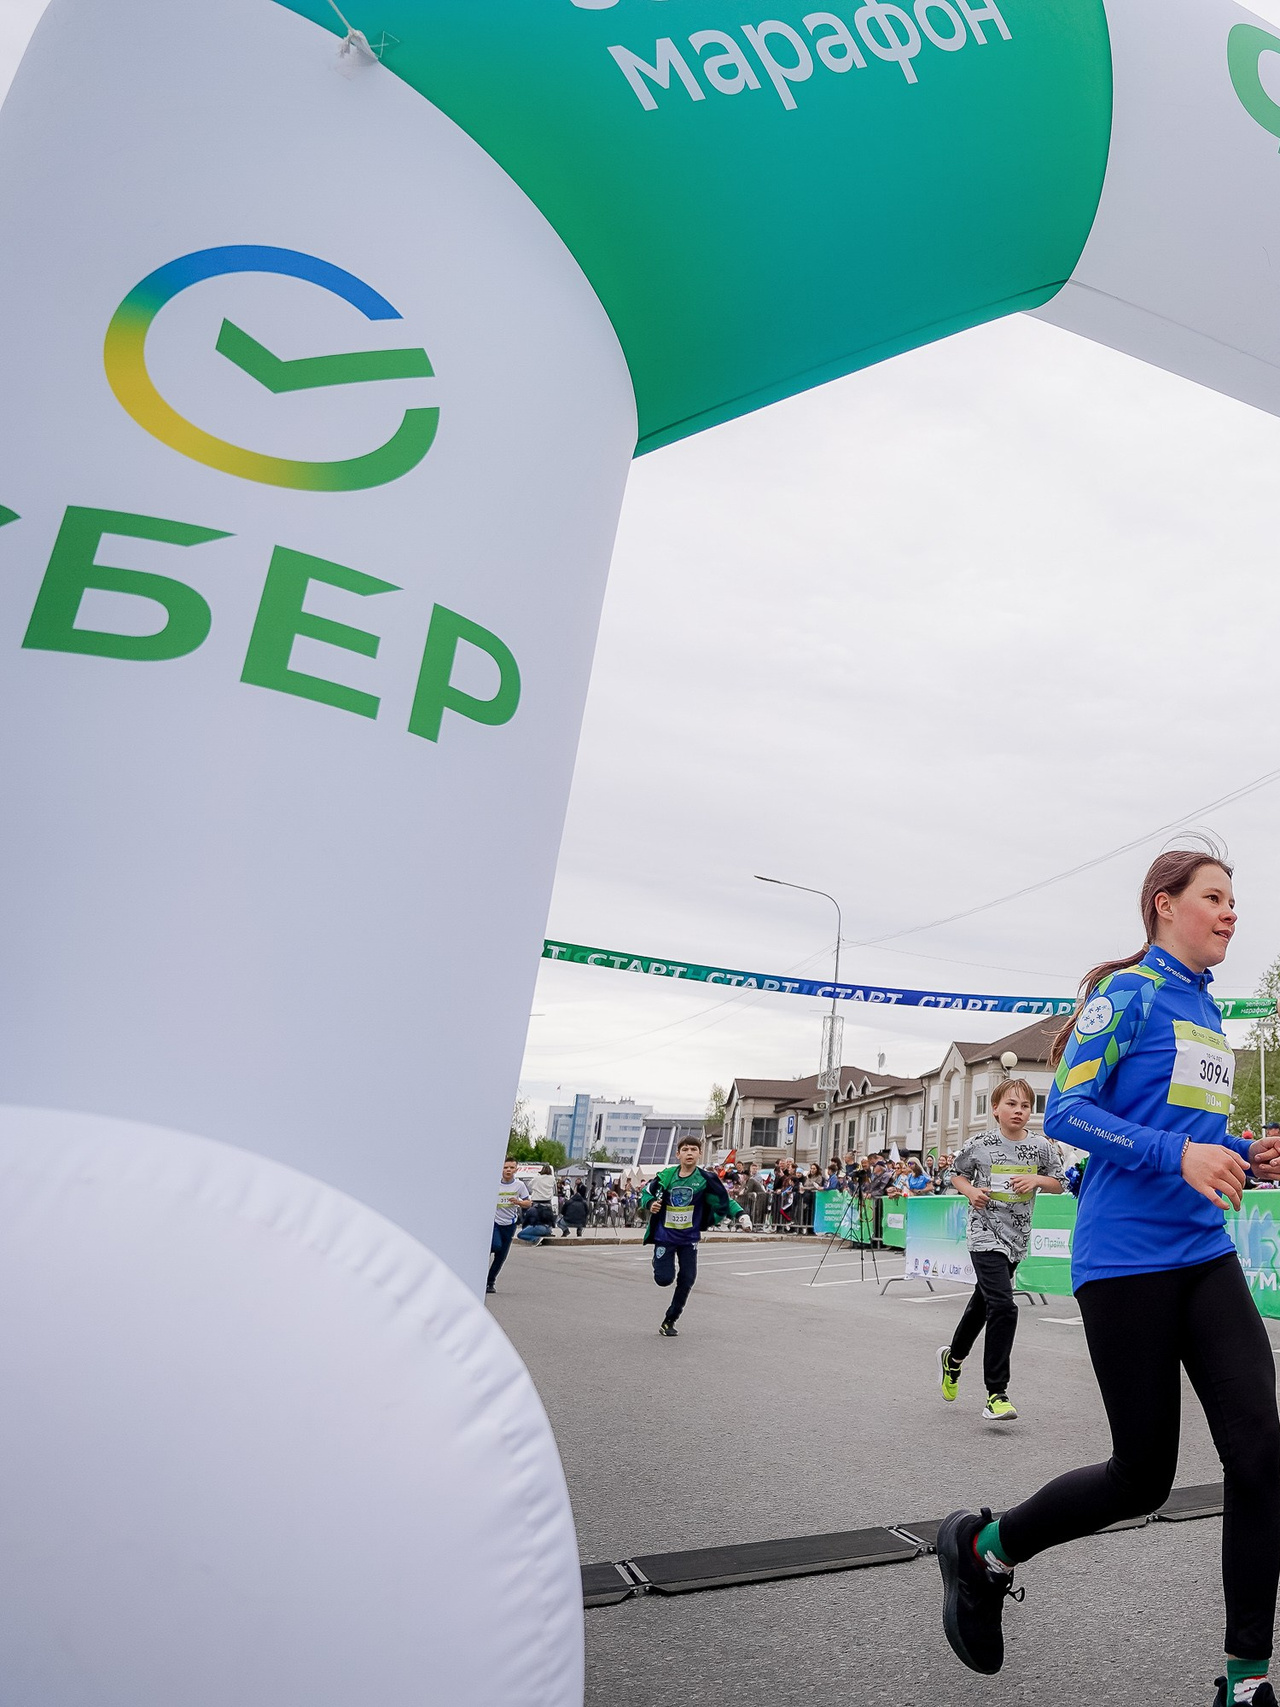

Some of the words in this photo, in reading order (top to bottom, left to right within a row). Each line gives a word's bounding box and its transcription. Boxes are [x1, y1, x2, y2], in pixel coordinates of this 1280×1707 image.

[607, 0, 1012, 111] марафон
[0, 504, 522, 743] БЕР
[587, 953, 687, 979] СТАРТ
[1199, 1059, 1230, 1087] 3094
[1067, 1115, 1135, 1149] ХАНТЫ-МАНСИЙСК
